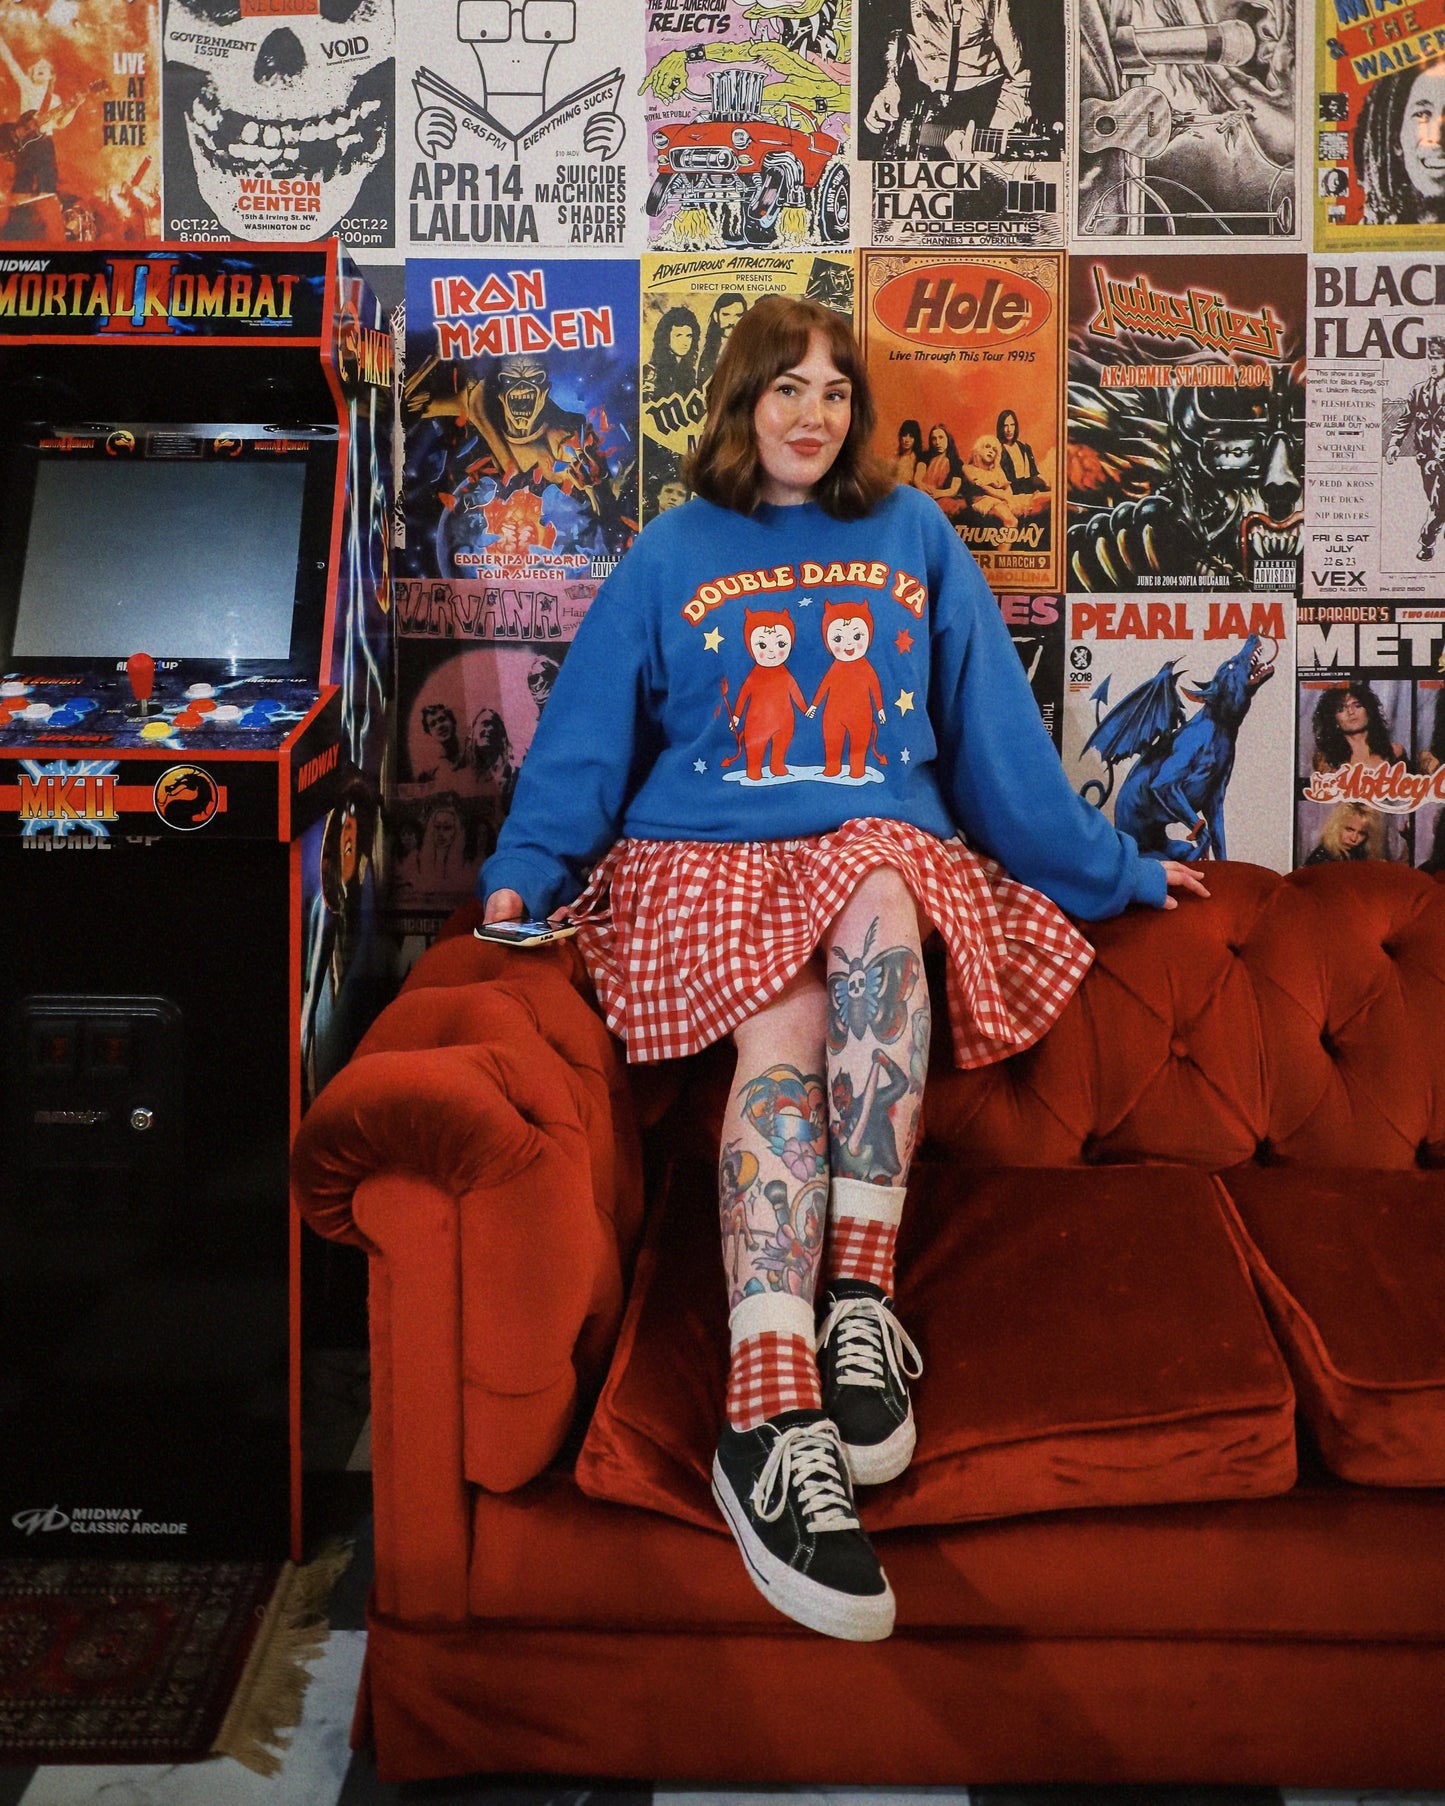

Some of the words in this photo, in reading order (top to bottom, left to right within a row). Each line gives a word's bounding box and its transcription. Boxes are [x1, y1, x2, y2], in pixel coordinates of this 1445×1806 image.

[648, 0, 663, 10] THE
[649, 13, 731, 34] REJECTS
[1361, 9, 1421, 46] THE
[169, 31, 257, 52] GOVERNMENT
[320, 36, 369, 59] VOID
[194, 44, 229, 58] ISSUE
[113, 53, 145, 75] LIVE
[127, 77, 145, 98] AT
[523, 105, 581, 151] EVERYTHING
[583, 88, 614, 111] SUCKS
[662, 110, 692, 119] REPUBLIC
[104, 125, 145, 146] PLATE
[461, 117, 487, 139] 6:45
[485, 133, 508, 151] PM
[409, 162, 479, 200] APR
[485, 164, 524, 201] 14
[556, 165, 626, 184] SUICIDE
[877, 162, 979, 189] BLACK
[240, 179, 321, 196] WILSON
[535, 184, 626, 203] MACHINES
[238, 196, 321, 212] CENTER
[877, 193, 953, 219] FLAG
[266, 214, 288, 222] Irving
[557, 205, 626, 225] SHADES
[171, 219, 219, 231] OCT.22
[245, 223, 298, 231] WASHINGTON
[340, 219, 388, 230] OCT.22
[570, 224, 626, 243] APART
[969, 236, 975, 244] &
[980, 236, 1018, 244] OVERKILL
[0, 259, 50, 271] IDWAY
[653, 258, 725, 281] ADVENTUROUS
[726, 256, 794, 270] ATTRACTIONS
[736, 274, 772, 282] PRESENTS
[1314, 264, 1445, 308] BLAC
[141, 273, 299, 318] KOMBAT
[432, 269, 547, 318] IRON
[691, 283, 718, 291] DIRECT
[721, 283, 745, 291] FROM
[904, 278, 1033, 334] Hole
[1089, 266, 1194, 342] Judas
[1187, 289, 1284, 360] Priest
[433, 305, 615, 360] MAIDEN
[1314, 317, 1427, 360] FLAG
[889, 351, 912, 361] Live
[914, 351, 956, 363] Through
[958, 351, 979, 361] This
[982, 351, 1004, 361] Tour
[1100, 365, 1172, 387] AKADEMIK
[1175, 364, 1236, 387] STADIUM
[1238, 364, 1272, 387] 2004
[1321, 400, 1376, 408] FLESHEATERS
[1322, 414, 1338, 422] THE
[1343, 414, 1367, 422] DICKS
[1319, 480, 1342, 488] REDD
[1347, 480, 1375, 488] KROSS
[1320, 495, 1335, 503] THE
[1340, 495, 1364, 503] DICKS
[1333, 512, 1369, 520] DRIVERS
[1326, 545, 1354, 553] JULY
[455, 554, 492, 565] EDDIE
[525, 554, 541, 565] UP
[1038, 556, 1047, 568] 9
[1324, 557, 1333, 566] 22
[477, 569, 510, 580] TOUR
[510, 569, 565, 580] SWEDEN
[1136, 575, 1154, 586] JUNE
[1154, 575, 1162, 586] 18
[1163, 575, 1178, 586] 2004
[1179, 575, 1198, 586] SOFIA
[1198, 575, 1230, 586] BULGARIA
[1254, 568, 1296, 583] ADVISORY
[1311, 571, 1366, 587] VEX
[683, 565, 796, 624] DOUBLE
[802, 562, 888, 586] DARE
[893, 572, 928, 616] YA
[993, 595, 1060, 625] ES
[1071, 602, 1194, 640] PEARL
[1203, 602, 1287, 640] JAM
[1070, 673, 1093, 682] 2018
[298, 742, 340, 793] MIDWAY
[72, 1508, 143, 1520] MIDWAY
[70, 1522, 129, 1533] CLASSIC
[131, 1523, 188, 1534] ARCADE
